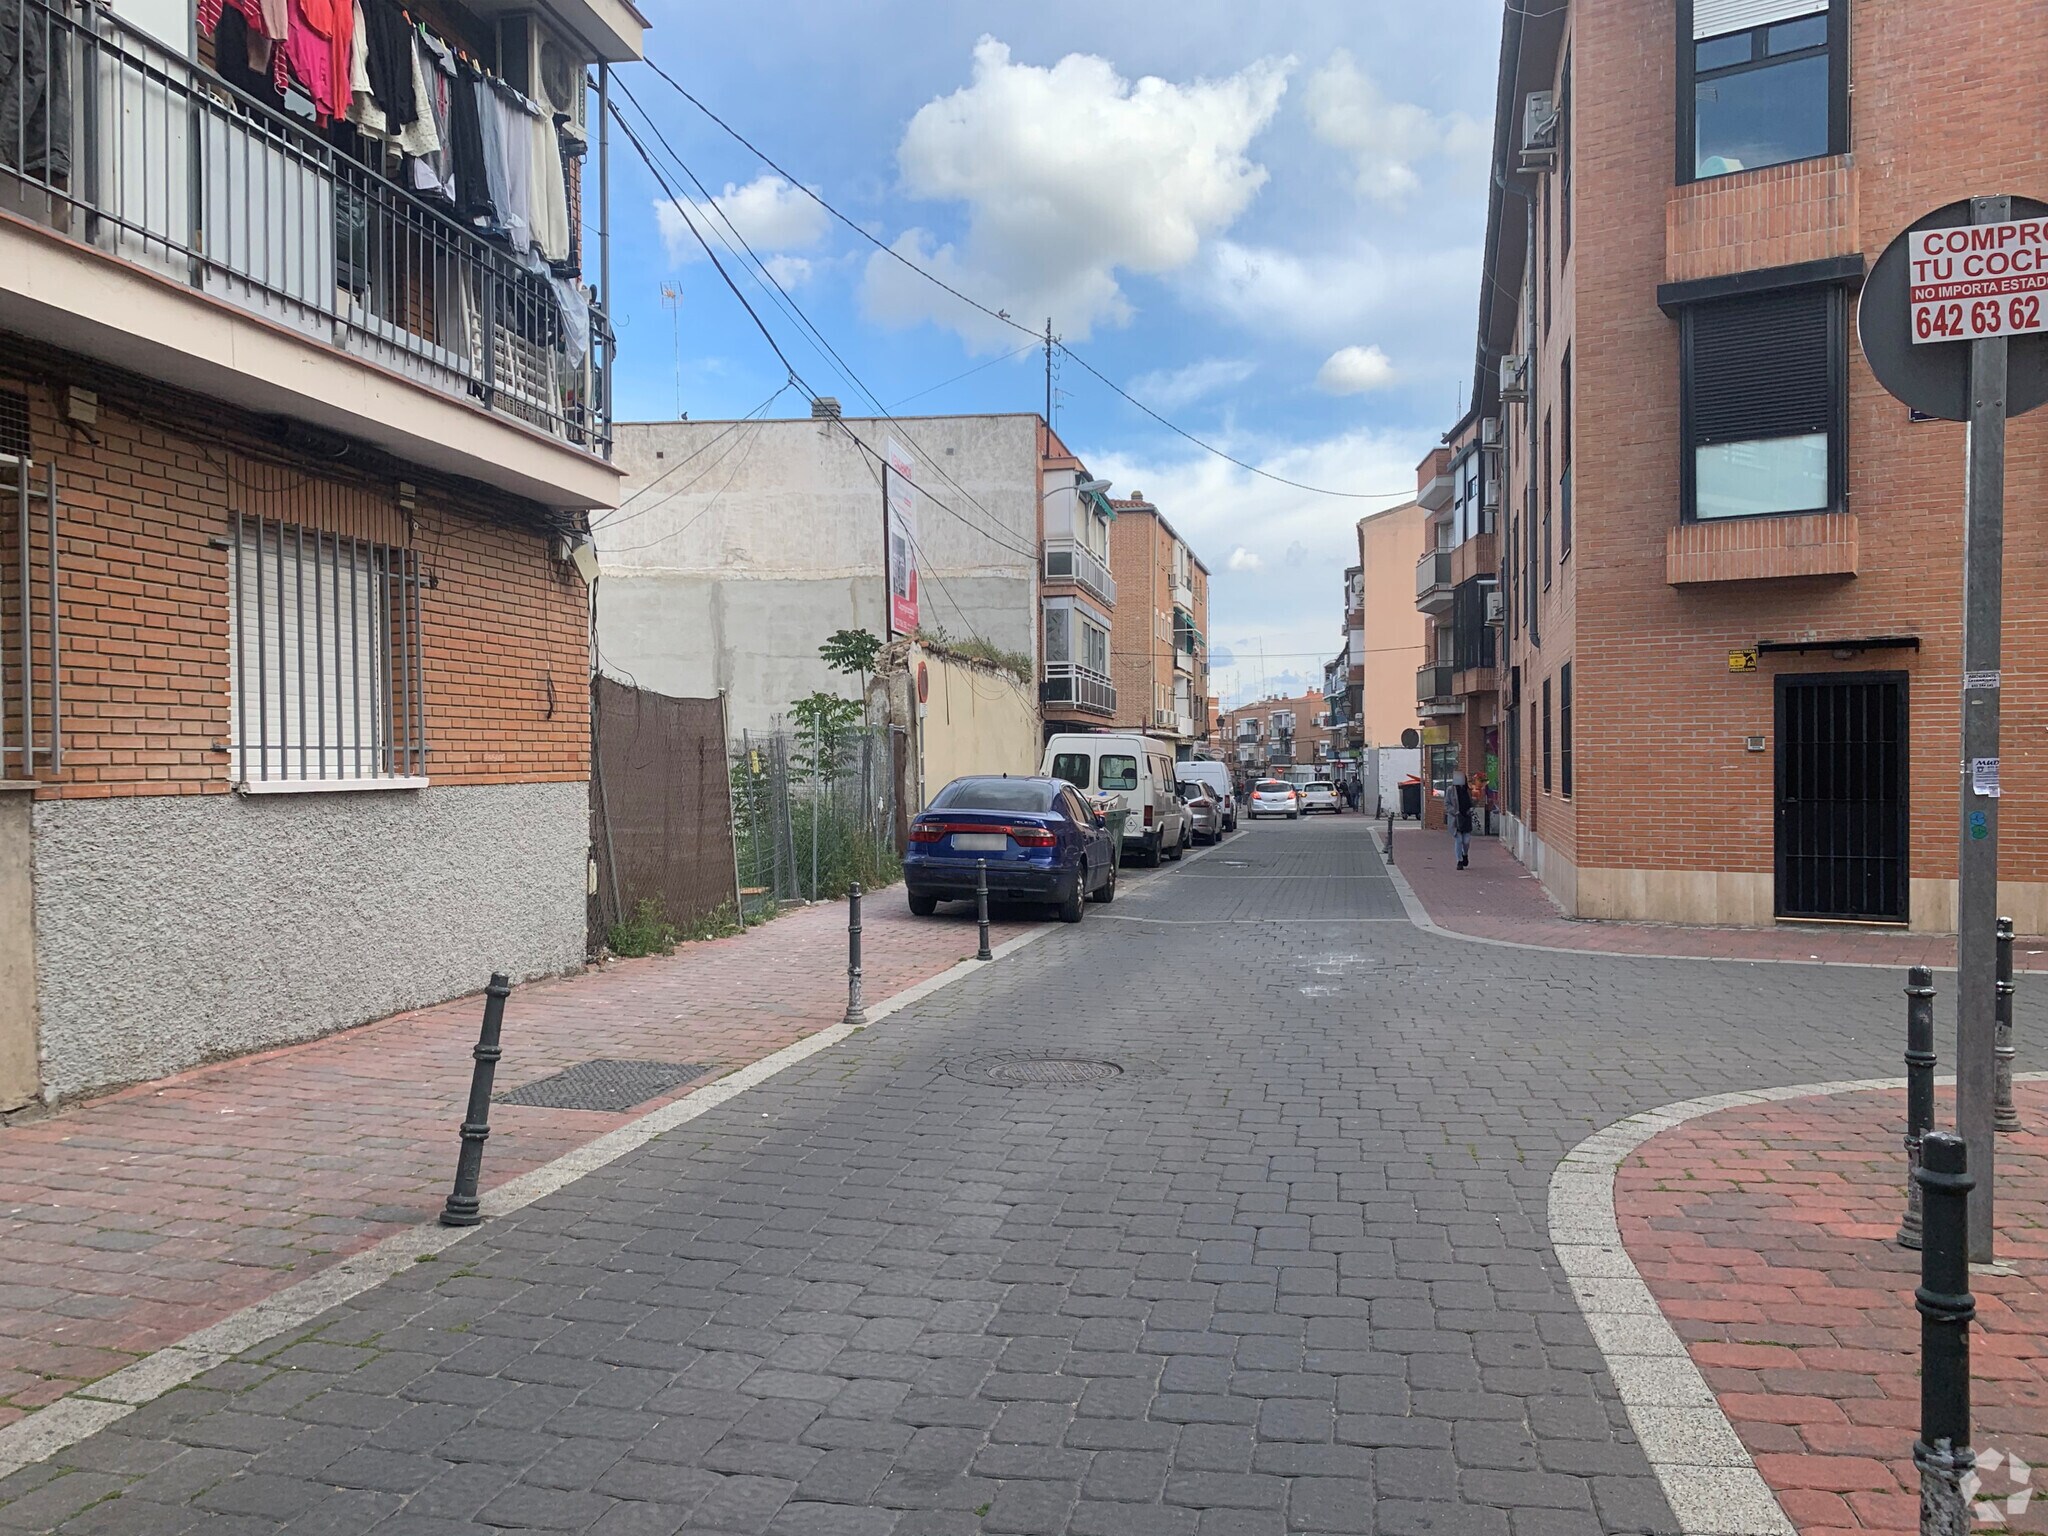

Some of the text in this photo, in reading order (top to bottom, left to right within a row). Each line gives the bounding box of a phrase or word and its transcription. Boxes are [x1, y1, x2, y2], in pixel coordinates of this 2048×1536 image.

[1923, 222, 2048, 256] COMPR
[1913, 257, 1953, 282] TU
[1915, 275, 2048, 300] NO IMPORTA ESTAD
[1916, 296, 2040, 339] 642 63 62
